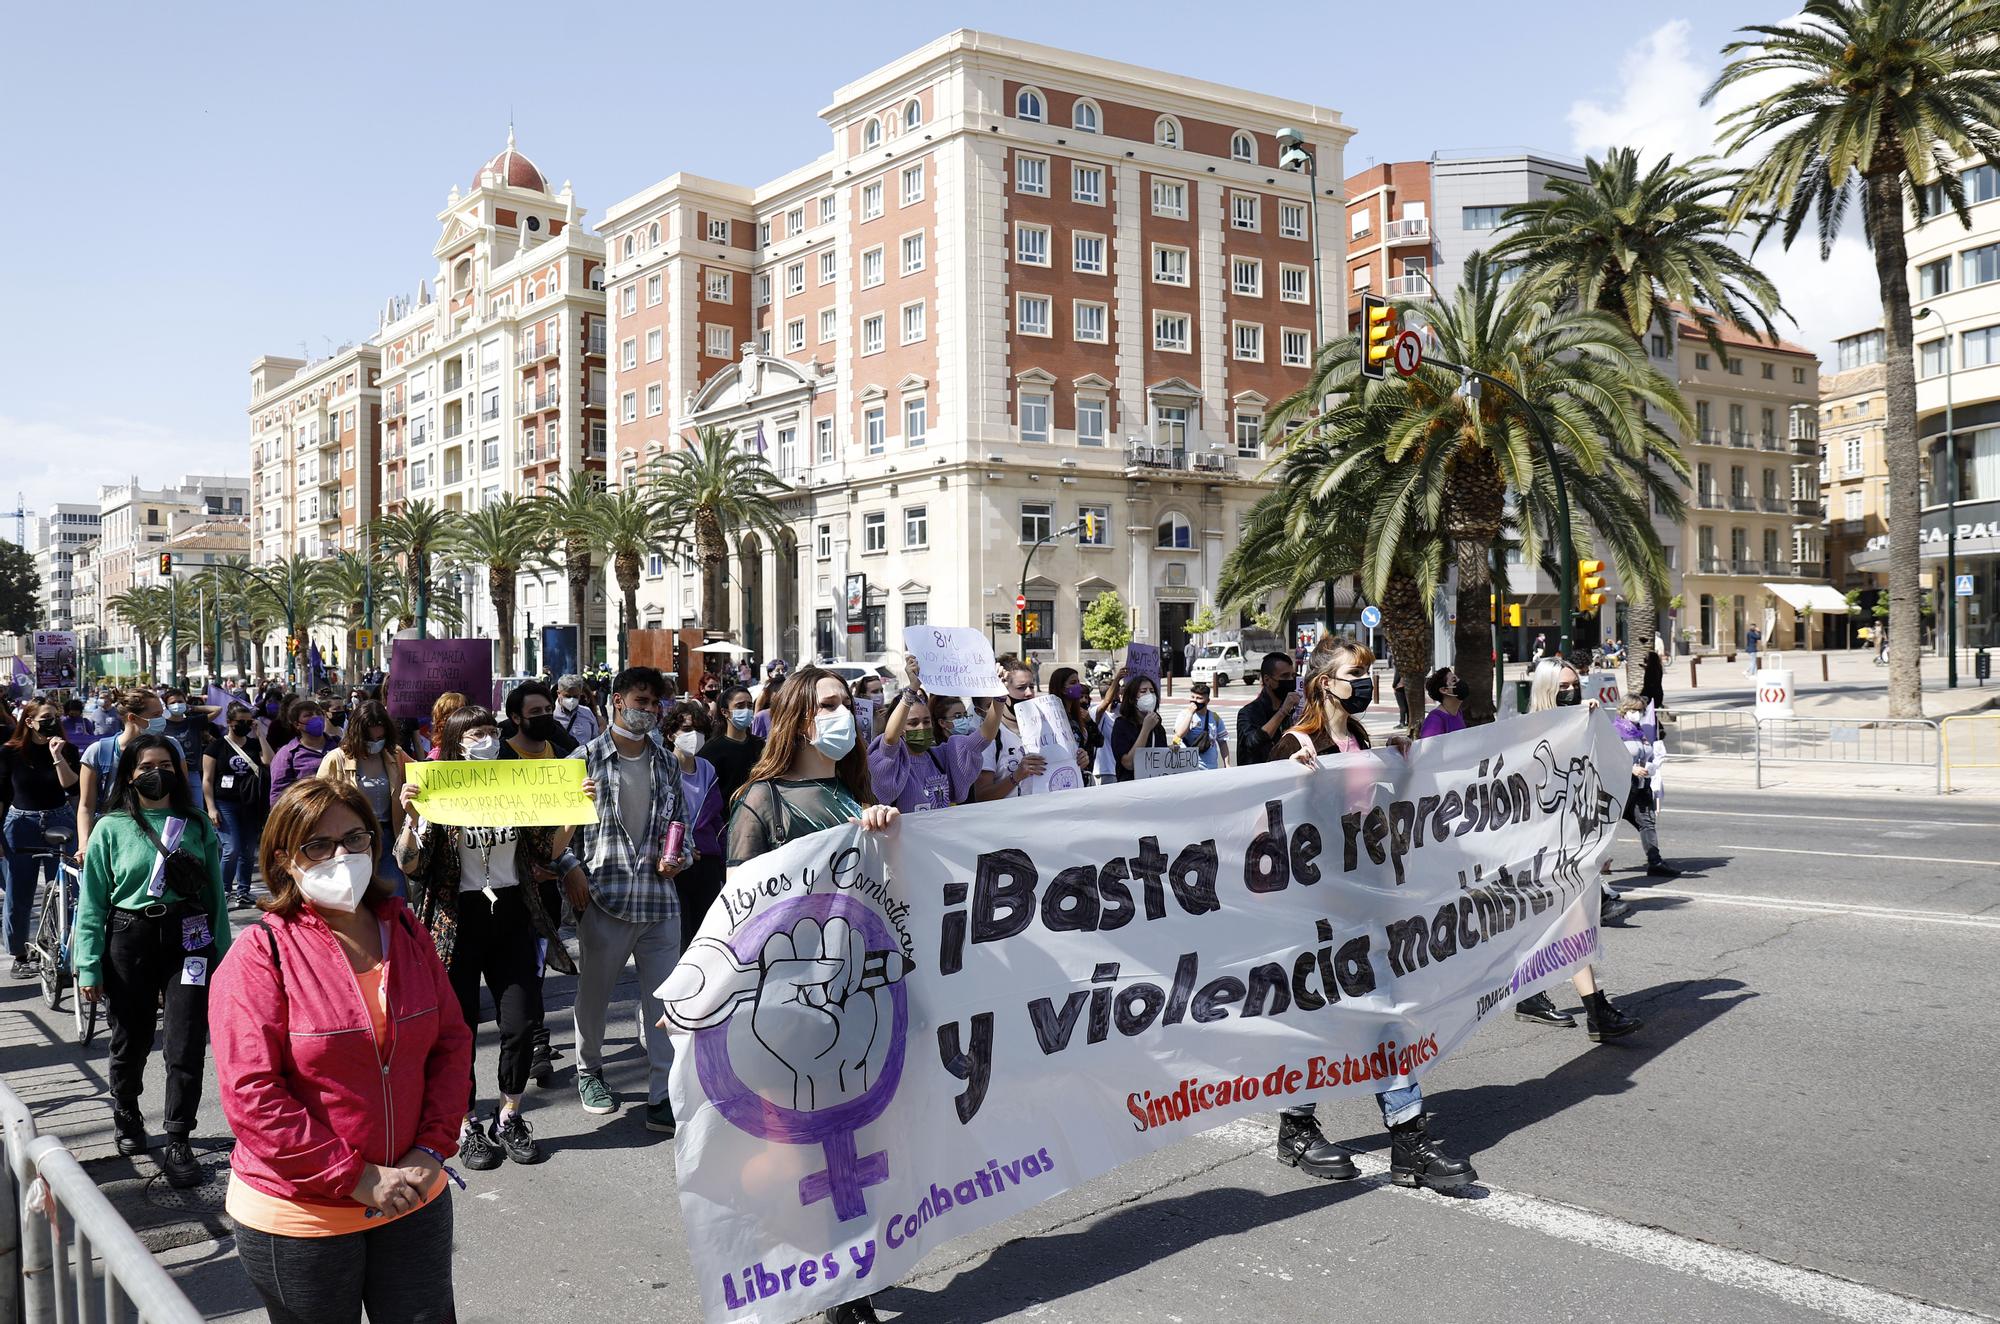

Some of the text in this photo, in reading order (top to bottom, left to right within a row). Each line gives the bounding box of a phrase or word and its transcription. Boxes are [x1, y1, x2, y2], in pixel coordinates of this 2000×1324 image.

[415, 765, 573, 791] NINGUNA MUJER
[532, 792, 562, 809] PARA
[563, 791, 586, 808] SER
[1144, 749, 1199, 770] ME QUIERO
[471, 810, 540, 826] VIOLADA
[940, 753, 1530, 975] ¡Basta de represión
[720, 847, 915, 959] Libres y Combativas
[937, 1012, 994, 1125] y
[1028, 919, 1376, 1055] violencia
[1127, 1031, 1439, 1132] Sindicato de Estudiantes
[722, 1147, 1055, 1310] Libres y Combativas
